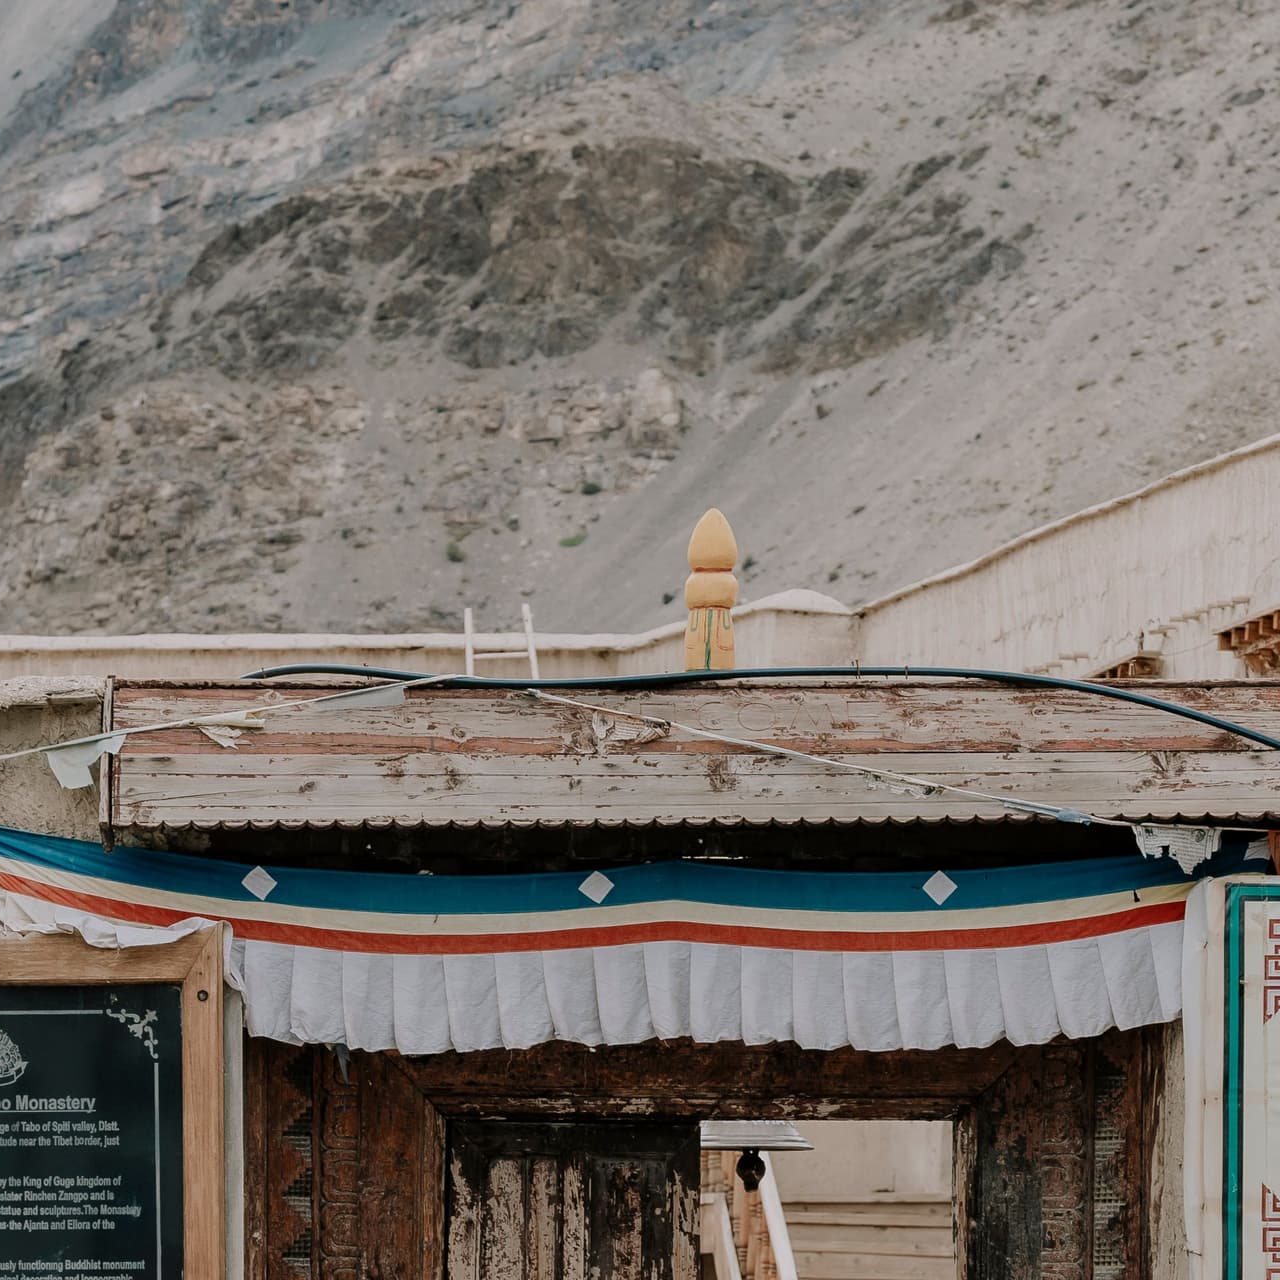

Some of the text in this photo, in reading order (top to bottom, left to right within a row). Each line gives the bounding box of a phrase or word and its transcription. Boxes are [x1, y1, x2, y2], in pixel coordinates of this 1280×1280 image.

[15, 1095, 95, 1114] Monastery
[21, 1122, 40, 1131] Tabo
[51, 1121, 70, 1133] Spiti
[71, 1121, 97, 1133] valley,
[18, 1138, 36, 1146] near
[37, 1136, 51, 1146] the
[53, 1136, 72, 1145] Tibet
[74, 1136, 102, 1147] border,
[104, 1136, 119, 1147] just
[22, 1176, 41, 1188] King
[76, 1176, 111, 1188] kingdom
[23, 1191, 56, 1201] Rinchen
[58, 1191, 88, 1203] Zangpo
[23, 1220, 49, 1232] Ajanta
[18, 1260, 63, 1272] functioning
[64, 1260, 101, 1270] Buddhist
[102, 1261, 145, 1269] monument
